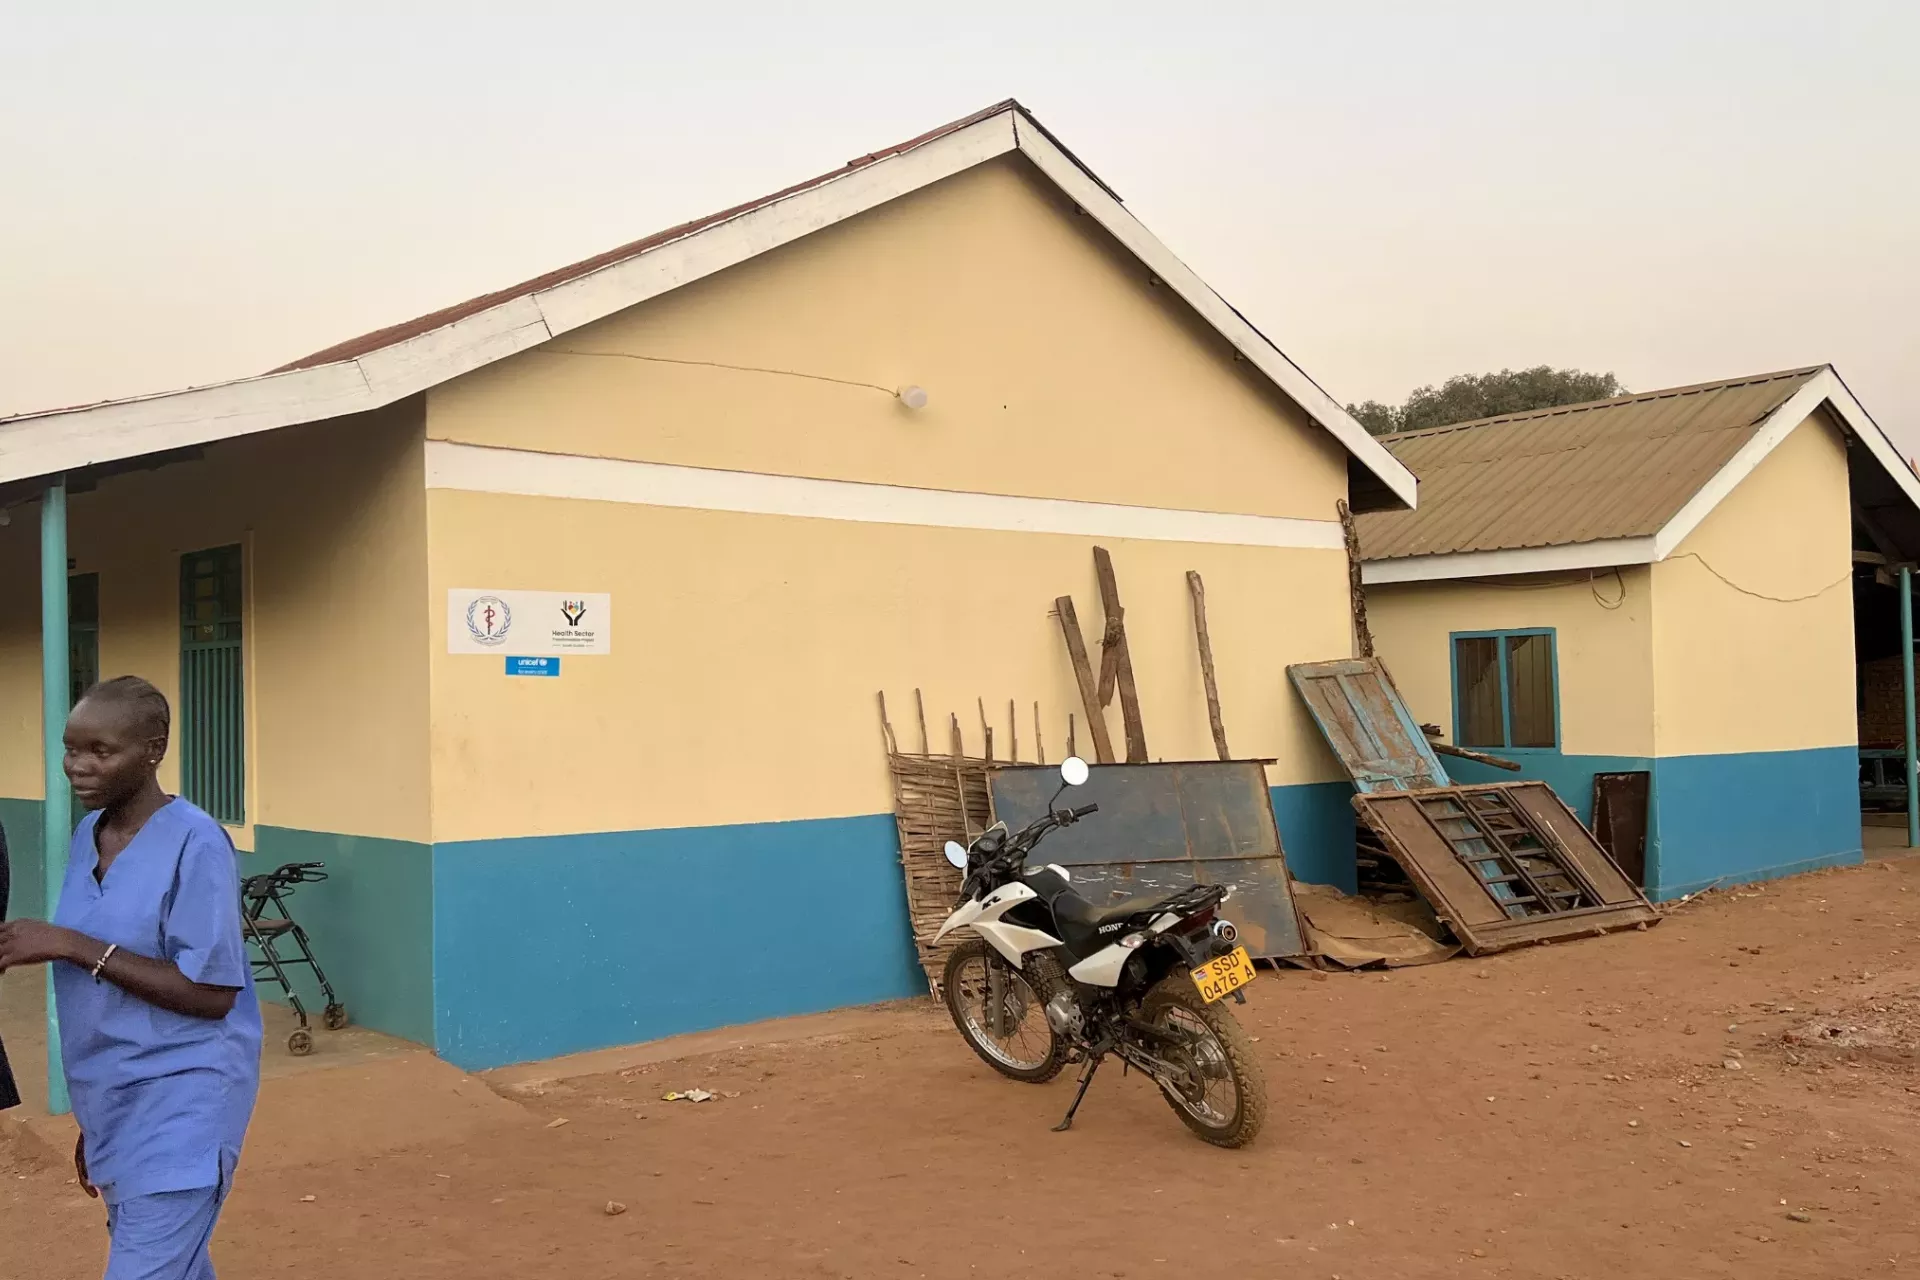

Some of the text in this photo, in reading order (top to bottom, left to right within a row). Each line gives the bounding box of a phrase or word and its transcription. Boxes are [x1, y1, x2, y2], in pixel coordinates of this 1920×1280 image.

[518, 658, 539, 666] unicef
[1212, 953, 1240, 976] SSD
[1203, 964, 1254, 1000] 0476 A
